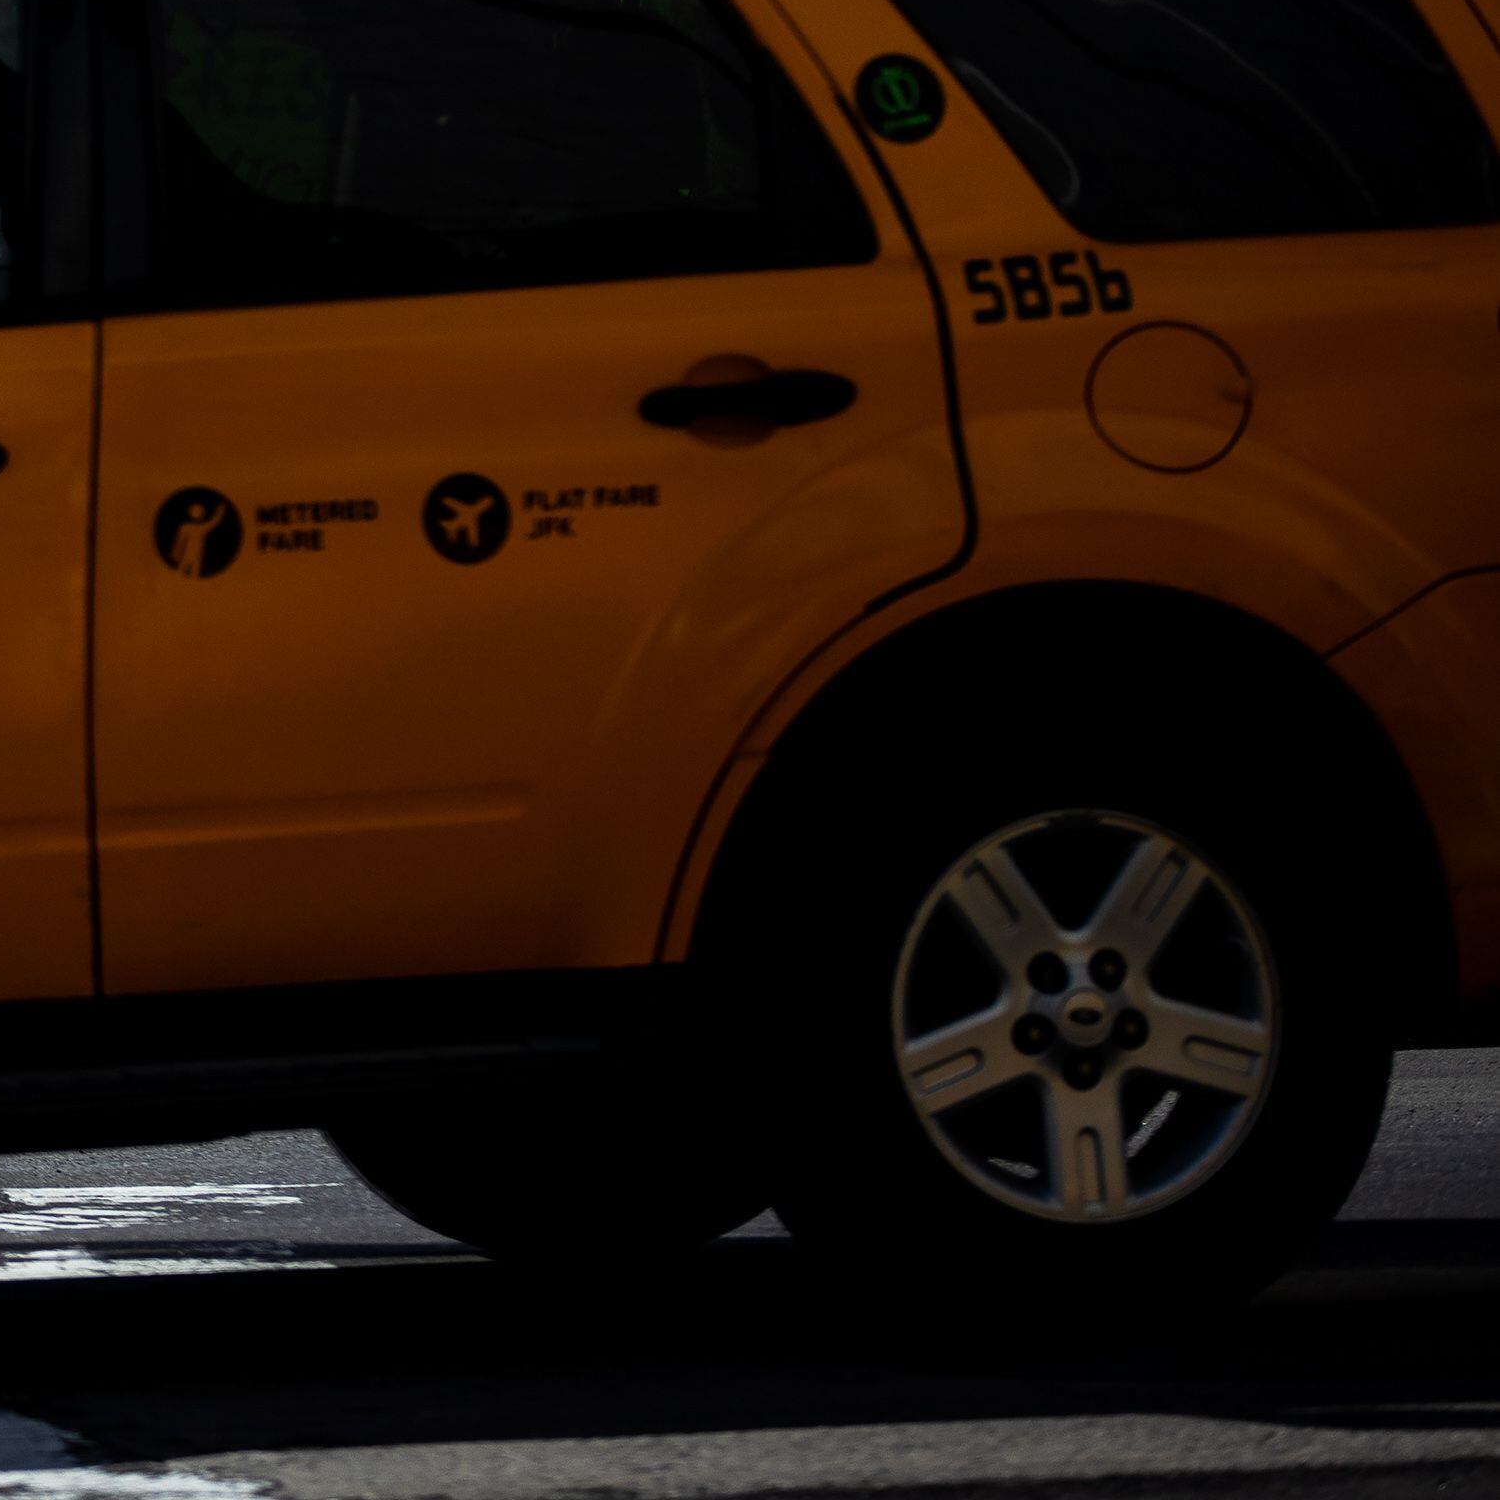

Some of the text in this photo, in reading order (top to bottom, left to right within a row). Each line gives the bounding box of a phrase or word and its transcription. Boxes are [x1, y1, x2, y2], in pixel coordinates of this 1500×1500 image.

[523, 484, 661, 512] FLAT FARE
[256, 499, 379, 526] METERED
[257, 529, 323, 552] FARE
